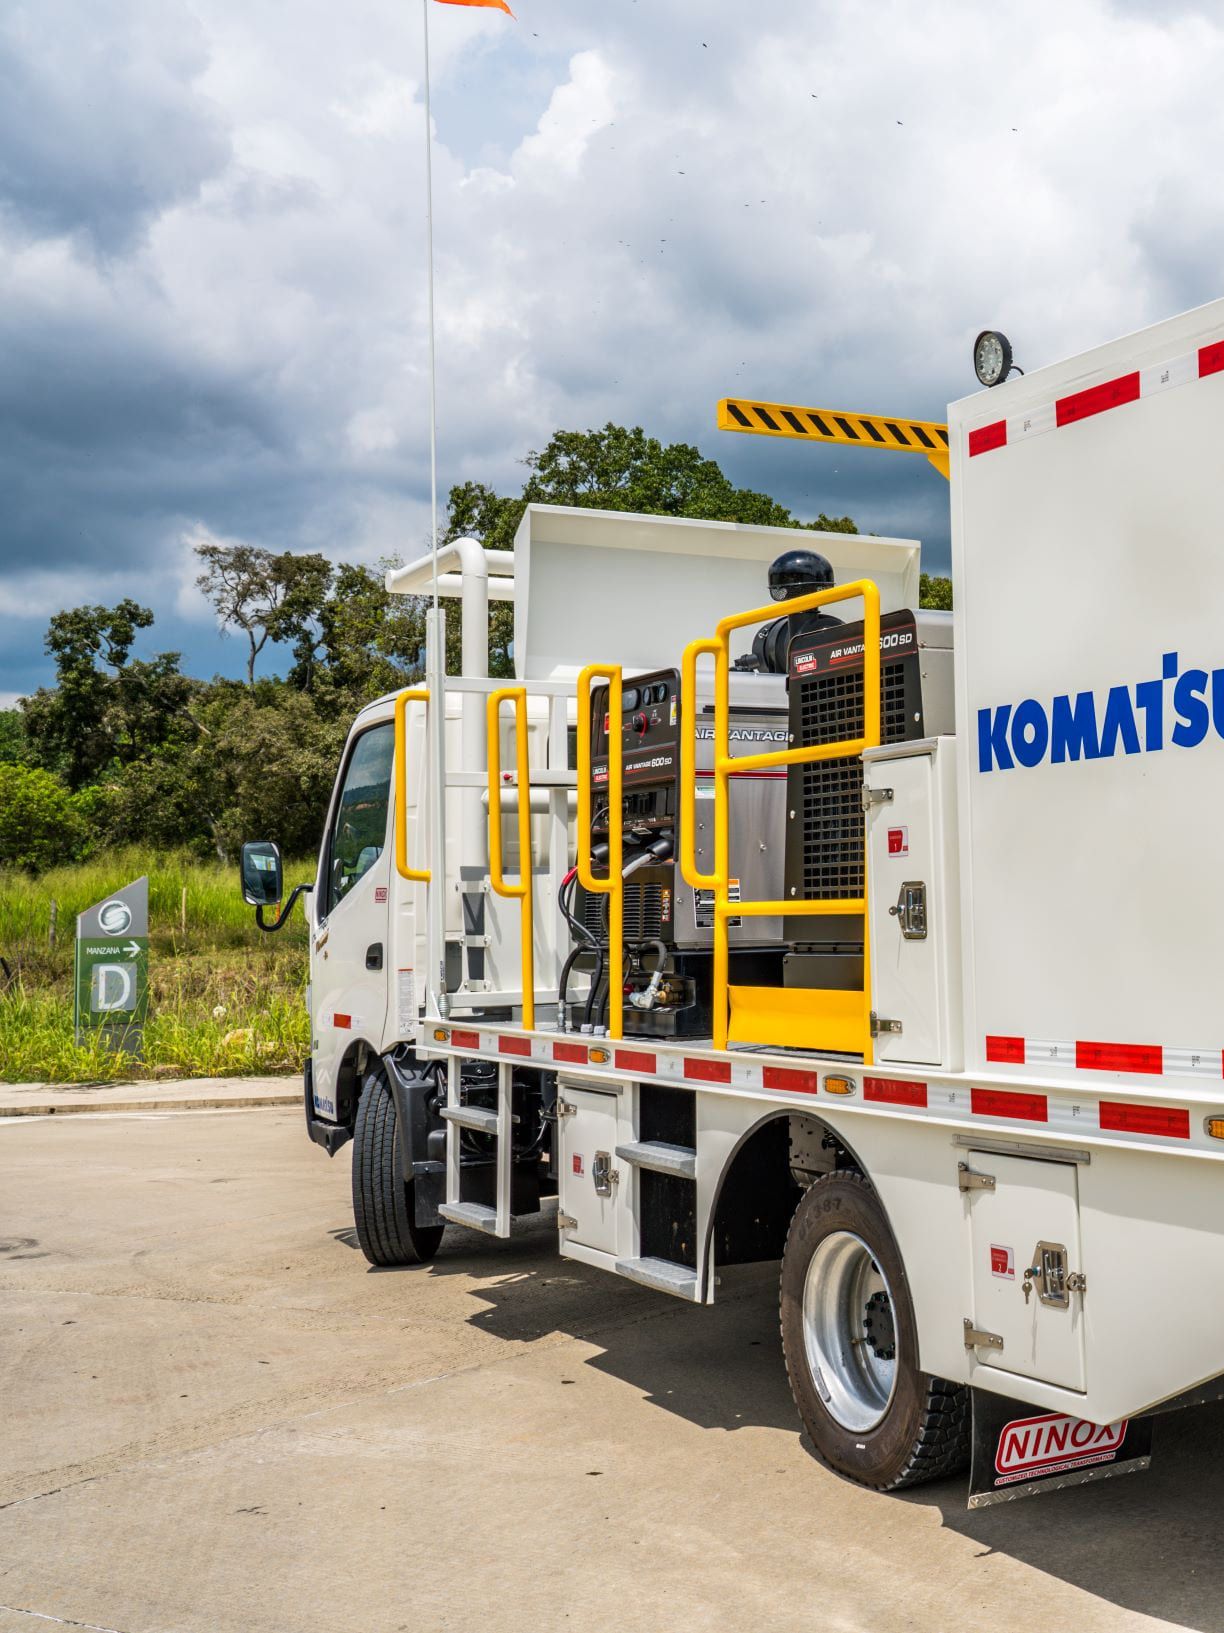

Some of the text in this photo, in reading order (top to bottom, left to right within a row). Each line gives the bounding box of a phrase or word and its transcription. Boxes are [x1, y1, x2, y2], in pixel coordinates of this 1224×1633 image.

[830, 648, 842, 659] AIR
[728, 728, 789, 742] ANTAG
[86, 946, 121, 955] MANZANA
[98, 965, 131, 1010] D
[1004, 1420, 1115, 1463] NINOX
[995, 1453, 1115, 1485] CUSTOMIZED TECHNOLOGICAL TRANSFORMATION
